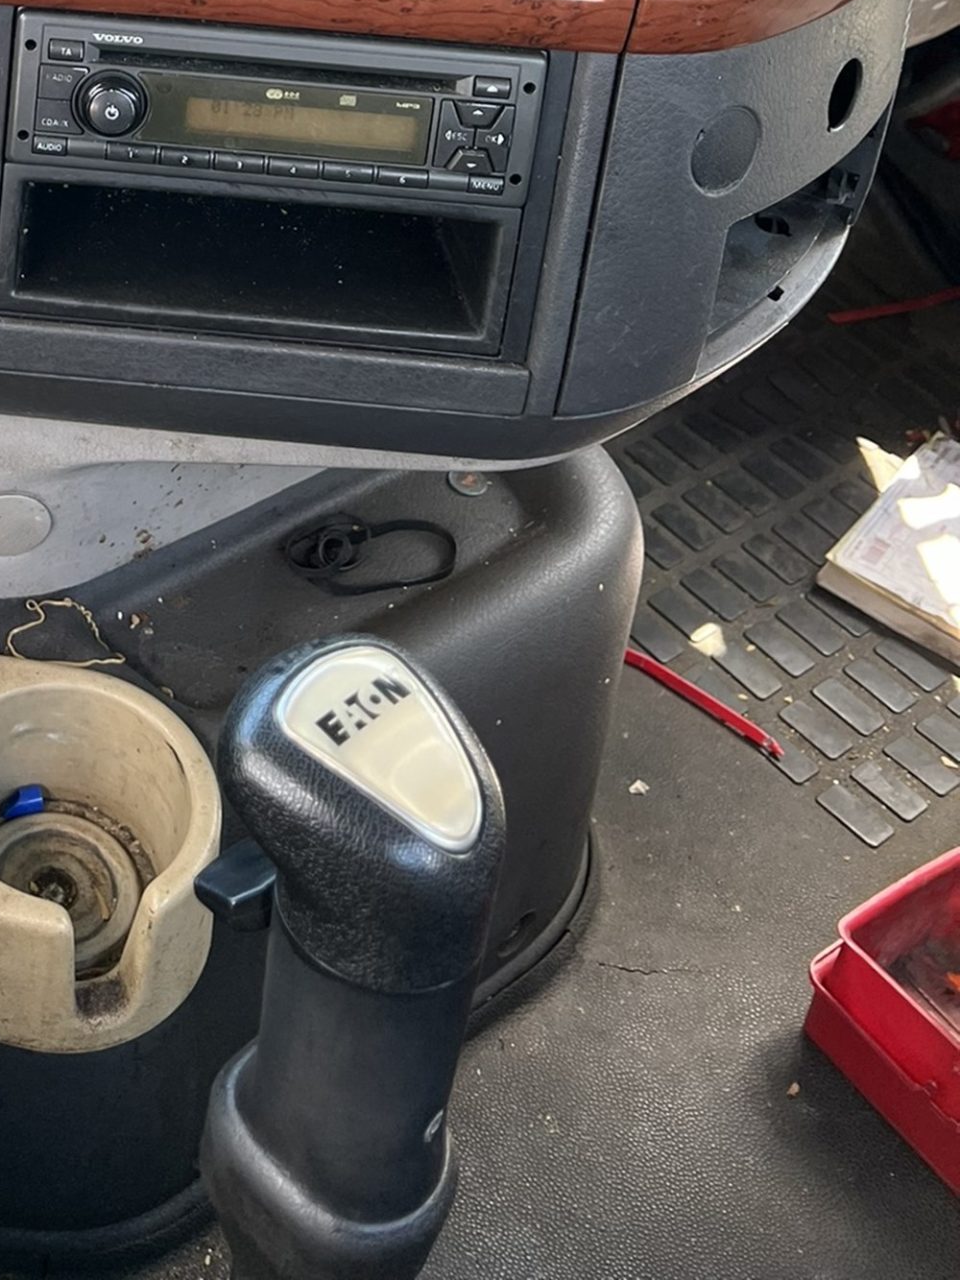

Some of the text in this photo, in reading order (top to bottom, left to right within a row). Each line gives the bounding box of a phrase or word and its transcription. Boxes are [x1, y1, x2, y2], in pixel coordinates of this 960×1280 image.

[92, 33, 144, 44] VOLVO
[36, 142, 63, 152] AUDIO
[472, 180, 500, 191] MENU
[316, 675, 411, 747] EATON
